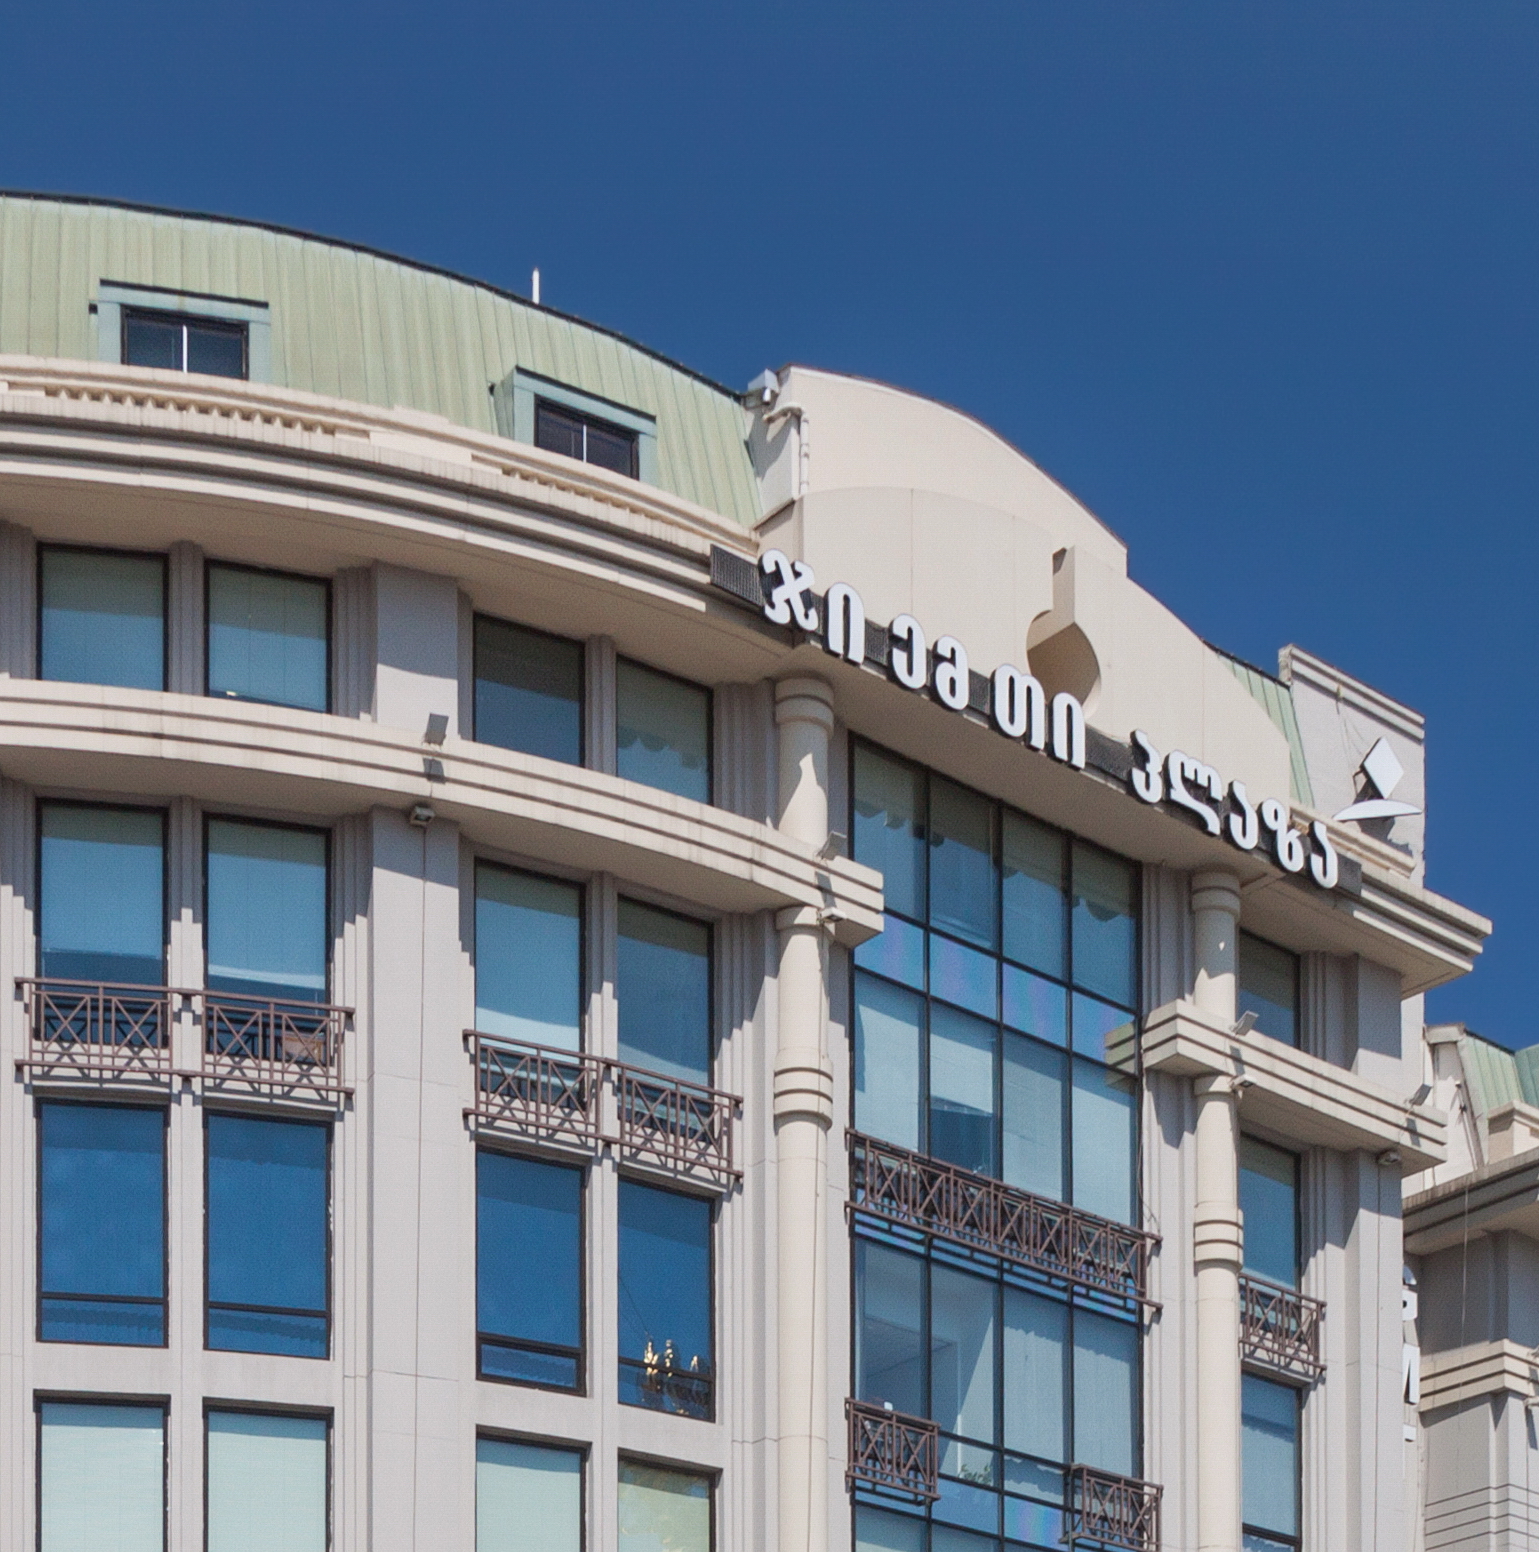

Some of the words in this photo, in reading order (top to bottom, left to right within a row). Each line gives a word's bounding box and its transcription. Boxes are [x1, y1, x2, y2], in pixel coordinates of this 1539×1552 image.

[759, 548, 865, 665] ჯი
[889, 613, 970, 711] ემ
[991, 663, 1086, 769] თი
